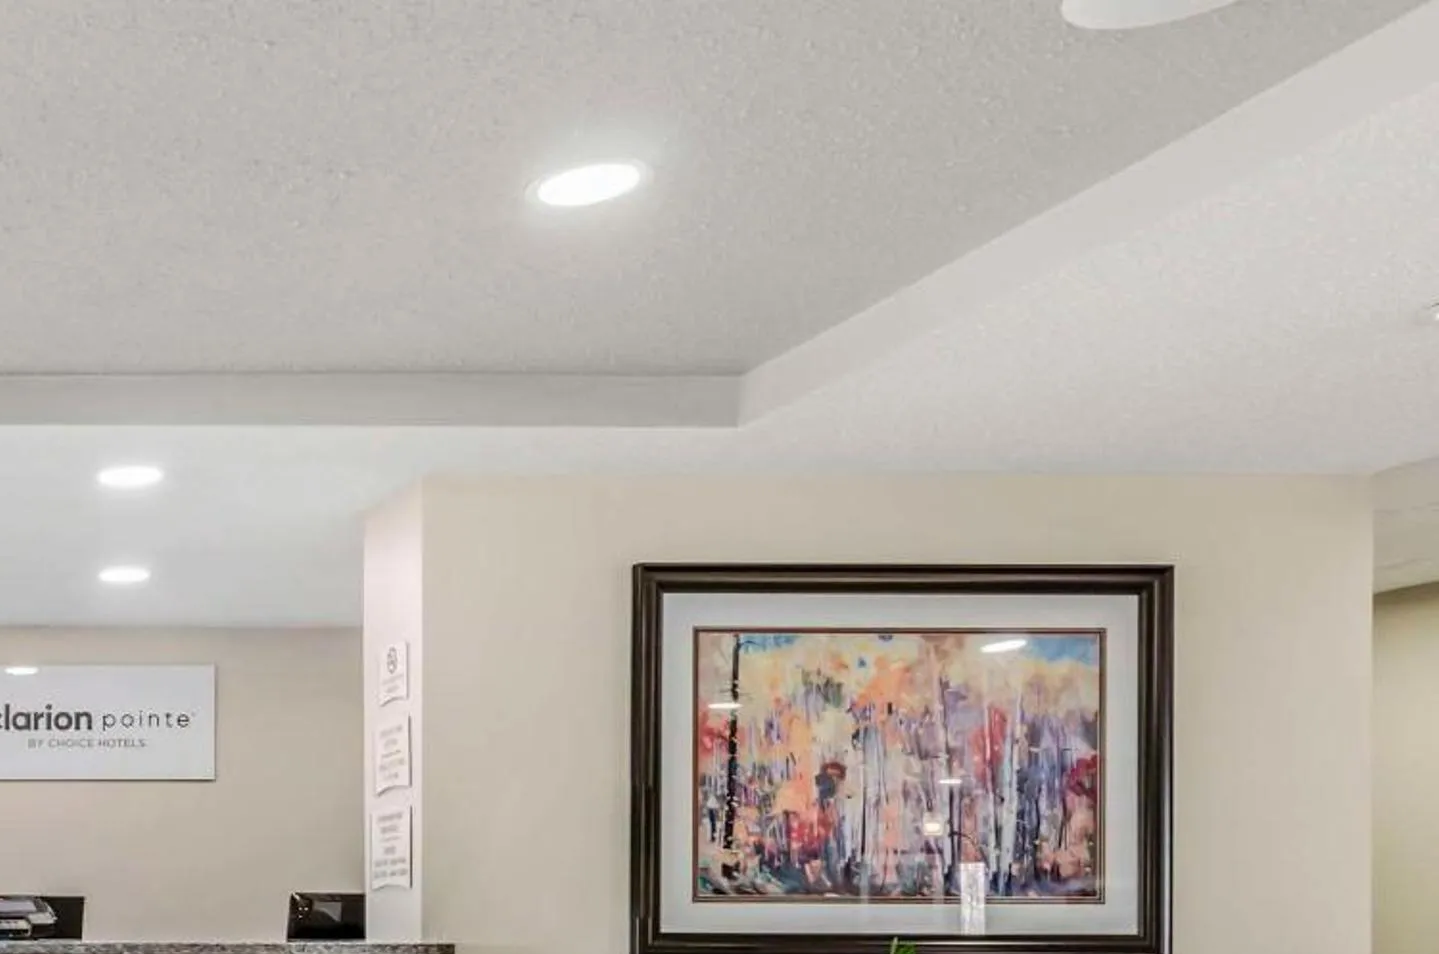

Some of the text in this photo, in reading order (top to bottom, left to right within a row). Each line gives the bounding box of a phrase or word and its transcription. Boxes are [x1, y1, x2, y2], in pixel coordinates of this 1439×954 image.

[101, 709, 190, 732] pointe
[27, 738, 147, 749] BY CHOICE HOTELS
